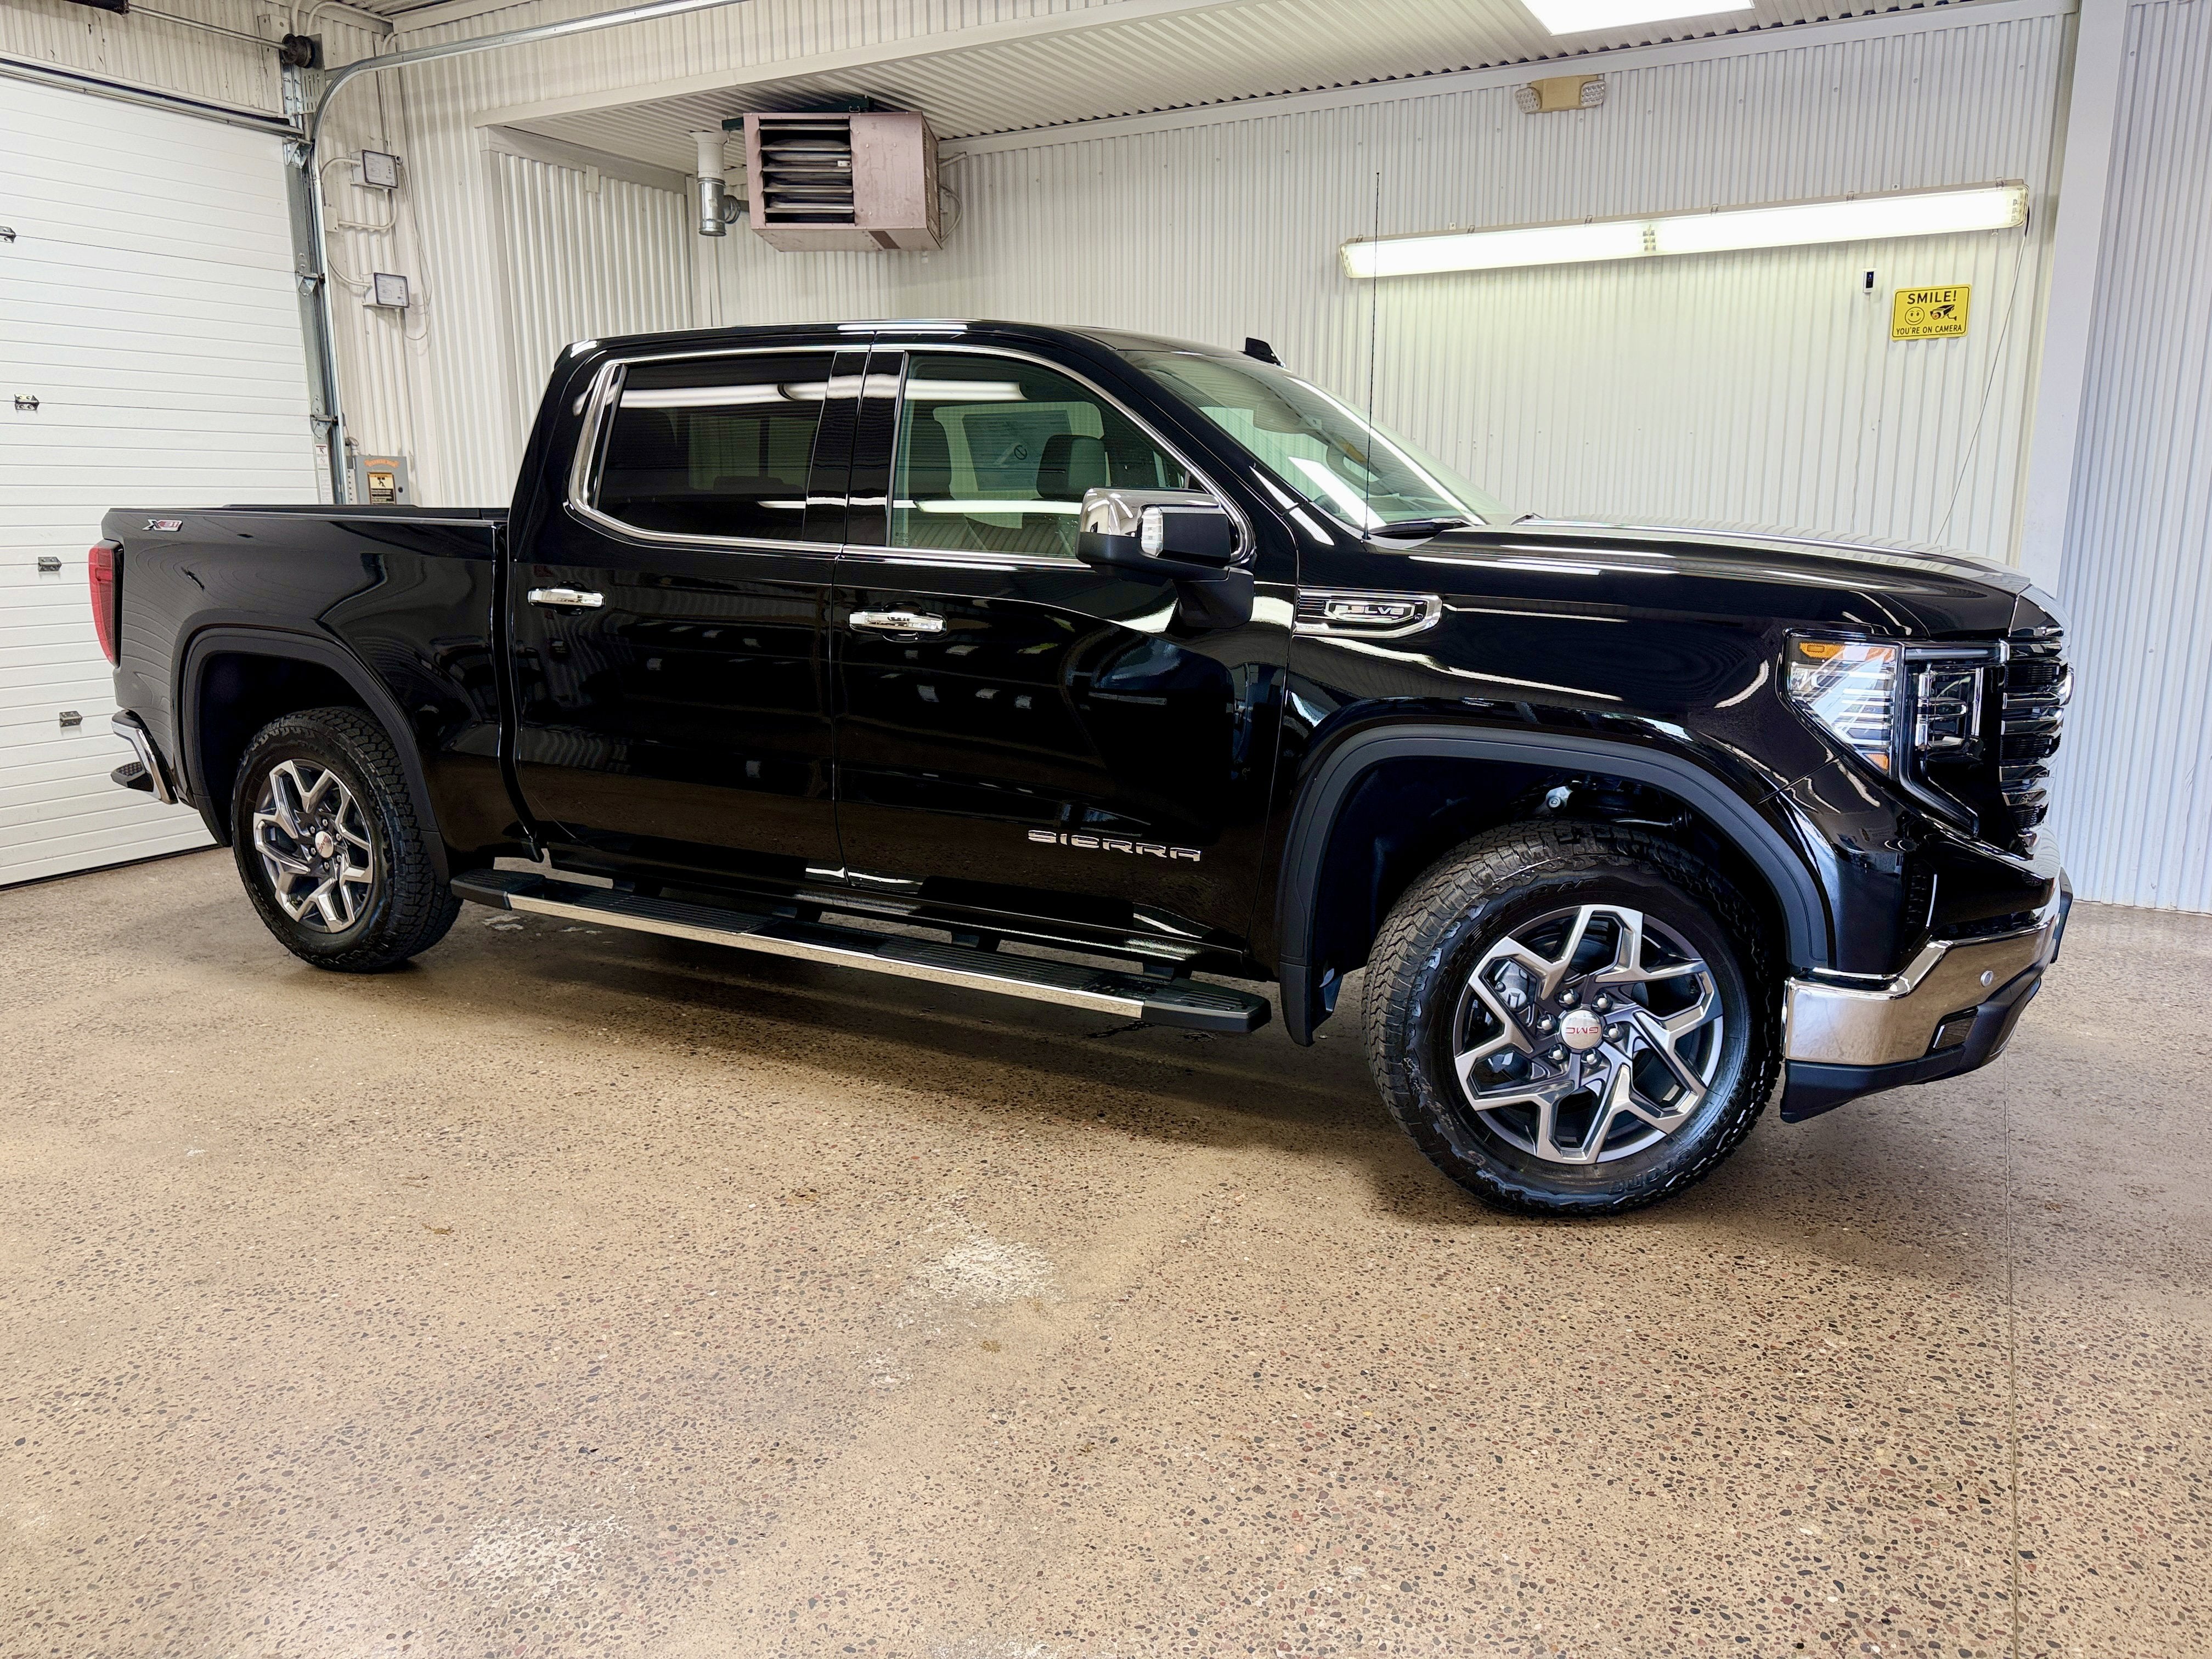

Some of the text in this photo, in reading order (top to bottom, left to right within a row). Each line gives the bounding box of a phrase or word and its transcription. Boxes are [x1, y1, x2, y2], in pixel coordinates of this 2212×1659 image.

[1907, 290, 1957, 304] SMILE!
[1897, 327, 1920, 335] YOU'RE
[1935, 324, 1962, 332] CAMERA
[142, 519, 183, 532] X31
[1028, 830, 1201, 861] SIERRA
